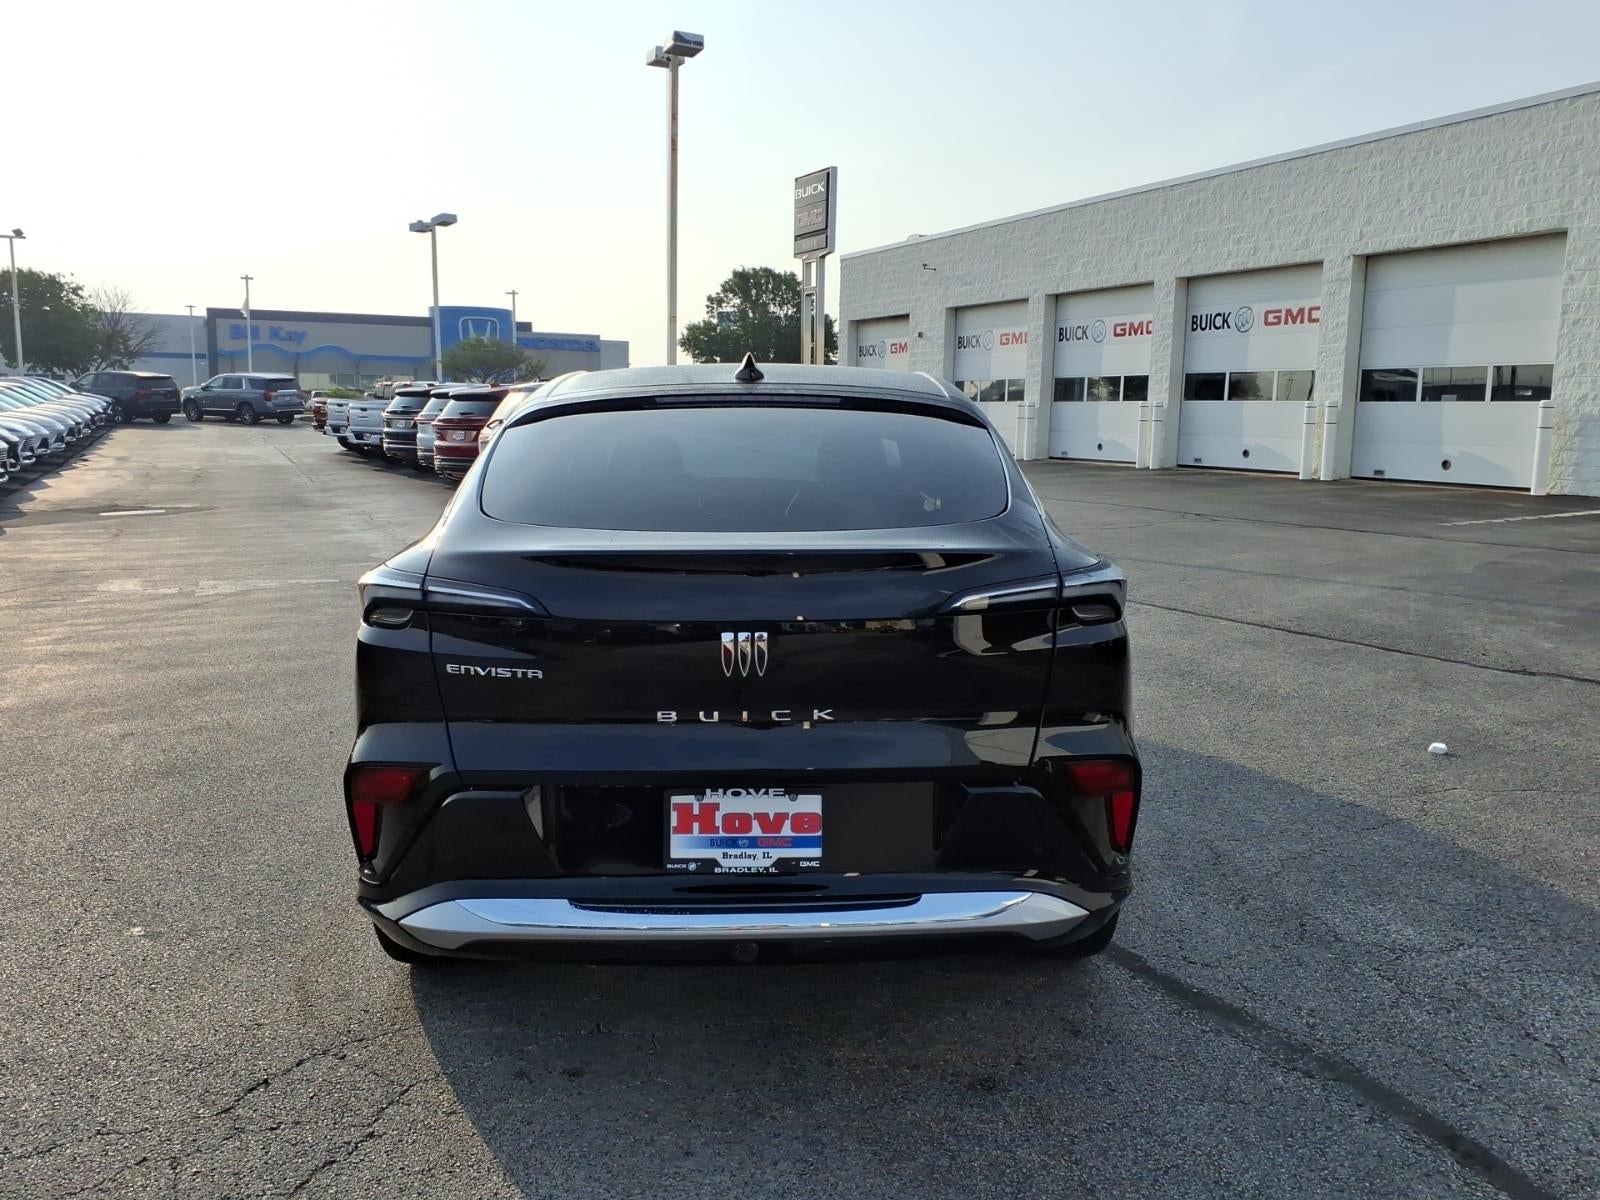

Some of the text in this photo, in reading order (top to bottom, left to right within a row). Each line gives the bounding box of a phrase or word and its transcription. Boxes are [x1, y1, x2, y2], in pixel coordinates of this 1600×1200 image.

[795, 181, 825, 200] BUICK
[1191, 306, 1320, 331] BUICK GMC
[957, 331, 1028, 349] BUICK GM
[1058, 325, 1089, 342] BUICK
[858, 342, 908, 357] BUICK GM
[446, 664, 543, 680] ENVISTA
[656, 708, 835, 723] BUICK
[705, 788, 786, 800] HOVE
[672, 802, 822, 834] Hove
[709, 837, 793, 848] BUICK GMC
[722, 852, 773, 861] Bradley, IL
[799, 860, 821, 868] GMC
[666, 862, 687, 870] BUICK
[714, 866, 779, 874] BRADLEY, IL
